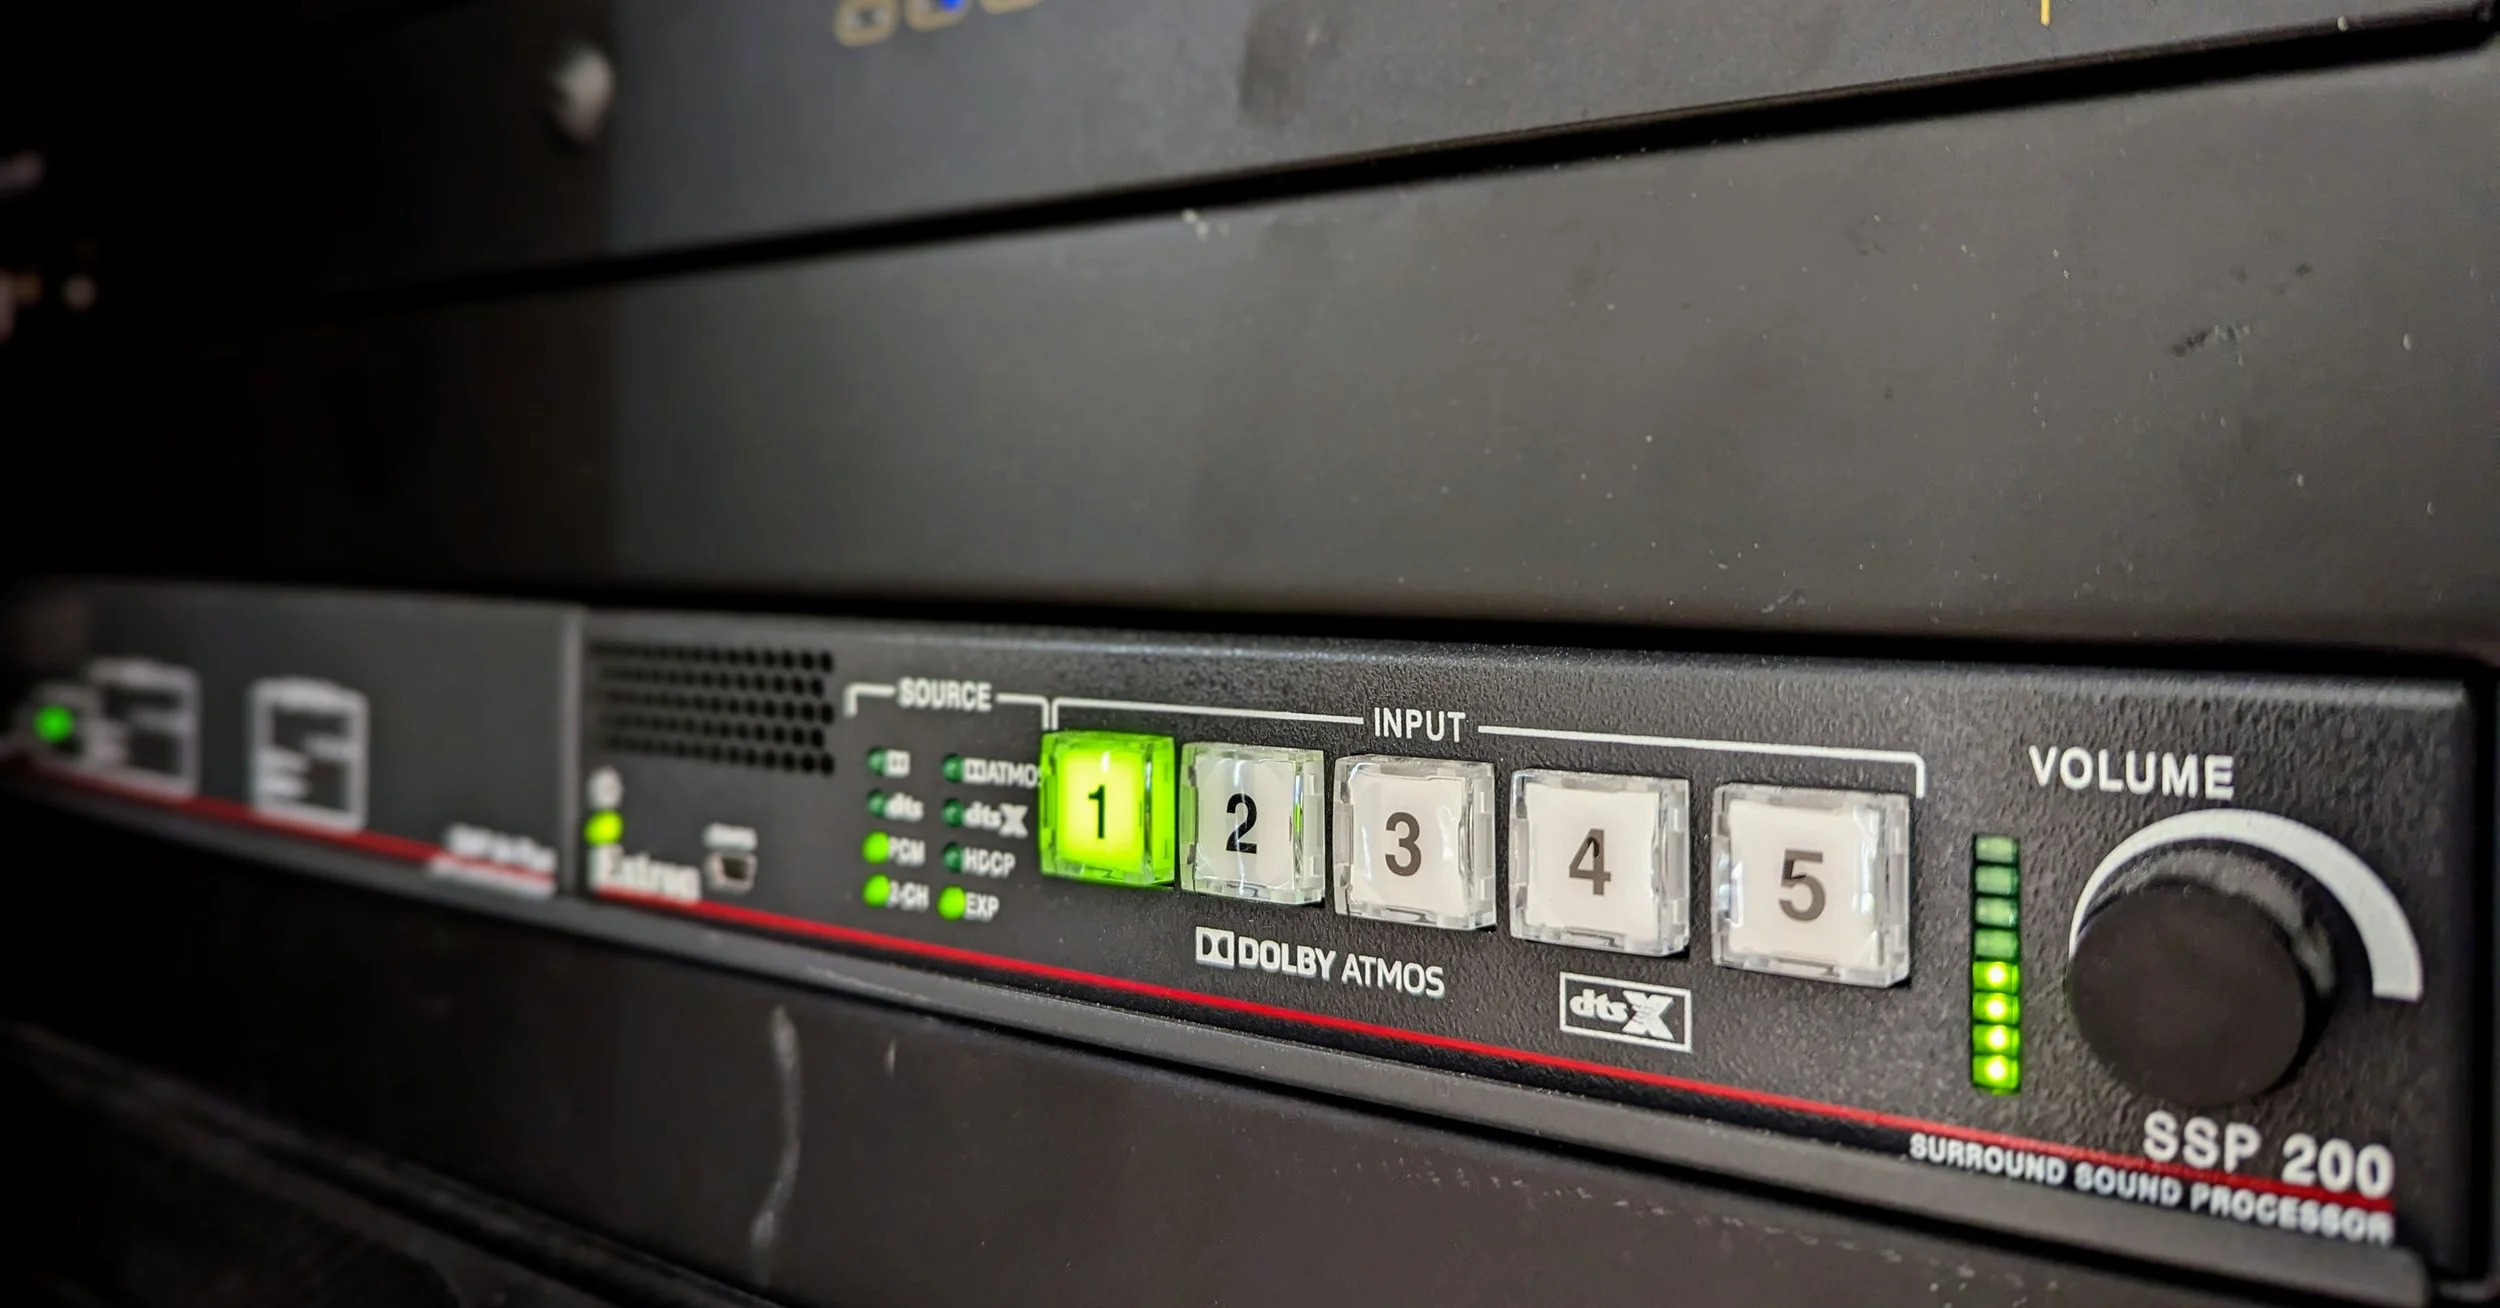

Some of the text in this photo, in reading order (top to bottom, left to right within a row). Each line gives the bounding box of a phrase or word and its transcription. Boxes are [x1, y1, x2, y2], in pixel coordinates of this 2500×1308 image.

[897, 677, 992, 711] SOURCE
[1374, 706, 1467, 743] INPUT
[2028, 745, 2235, 800] VOLUME
[1087, 784, 1106, 840] 1
[1225, 793, 1258, 855] 2
[888, 836, 926, 867] PCM
[963, 846, 1017, 878] HDCP
[1384, 811, 1423, 877] 3
[1568, 828, 1612, 896] 4
[966, 892, 1000, 921] EXP
[1778, 849, 1828, 923] 5
[1239, 936, 1446, 998] DOLBY ATMOS
[2141, 1109, 2395, 1199] SSP 200
[1909, 1131, 2395, 1247] SURROUND SOUND PROCESSOR
